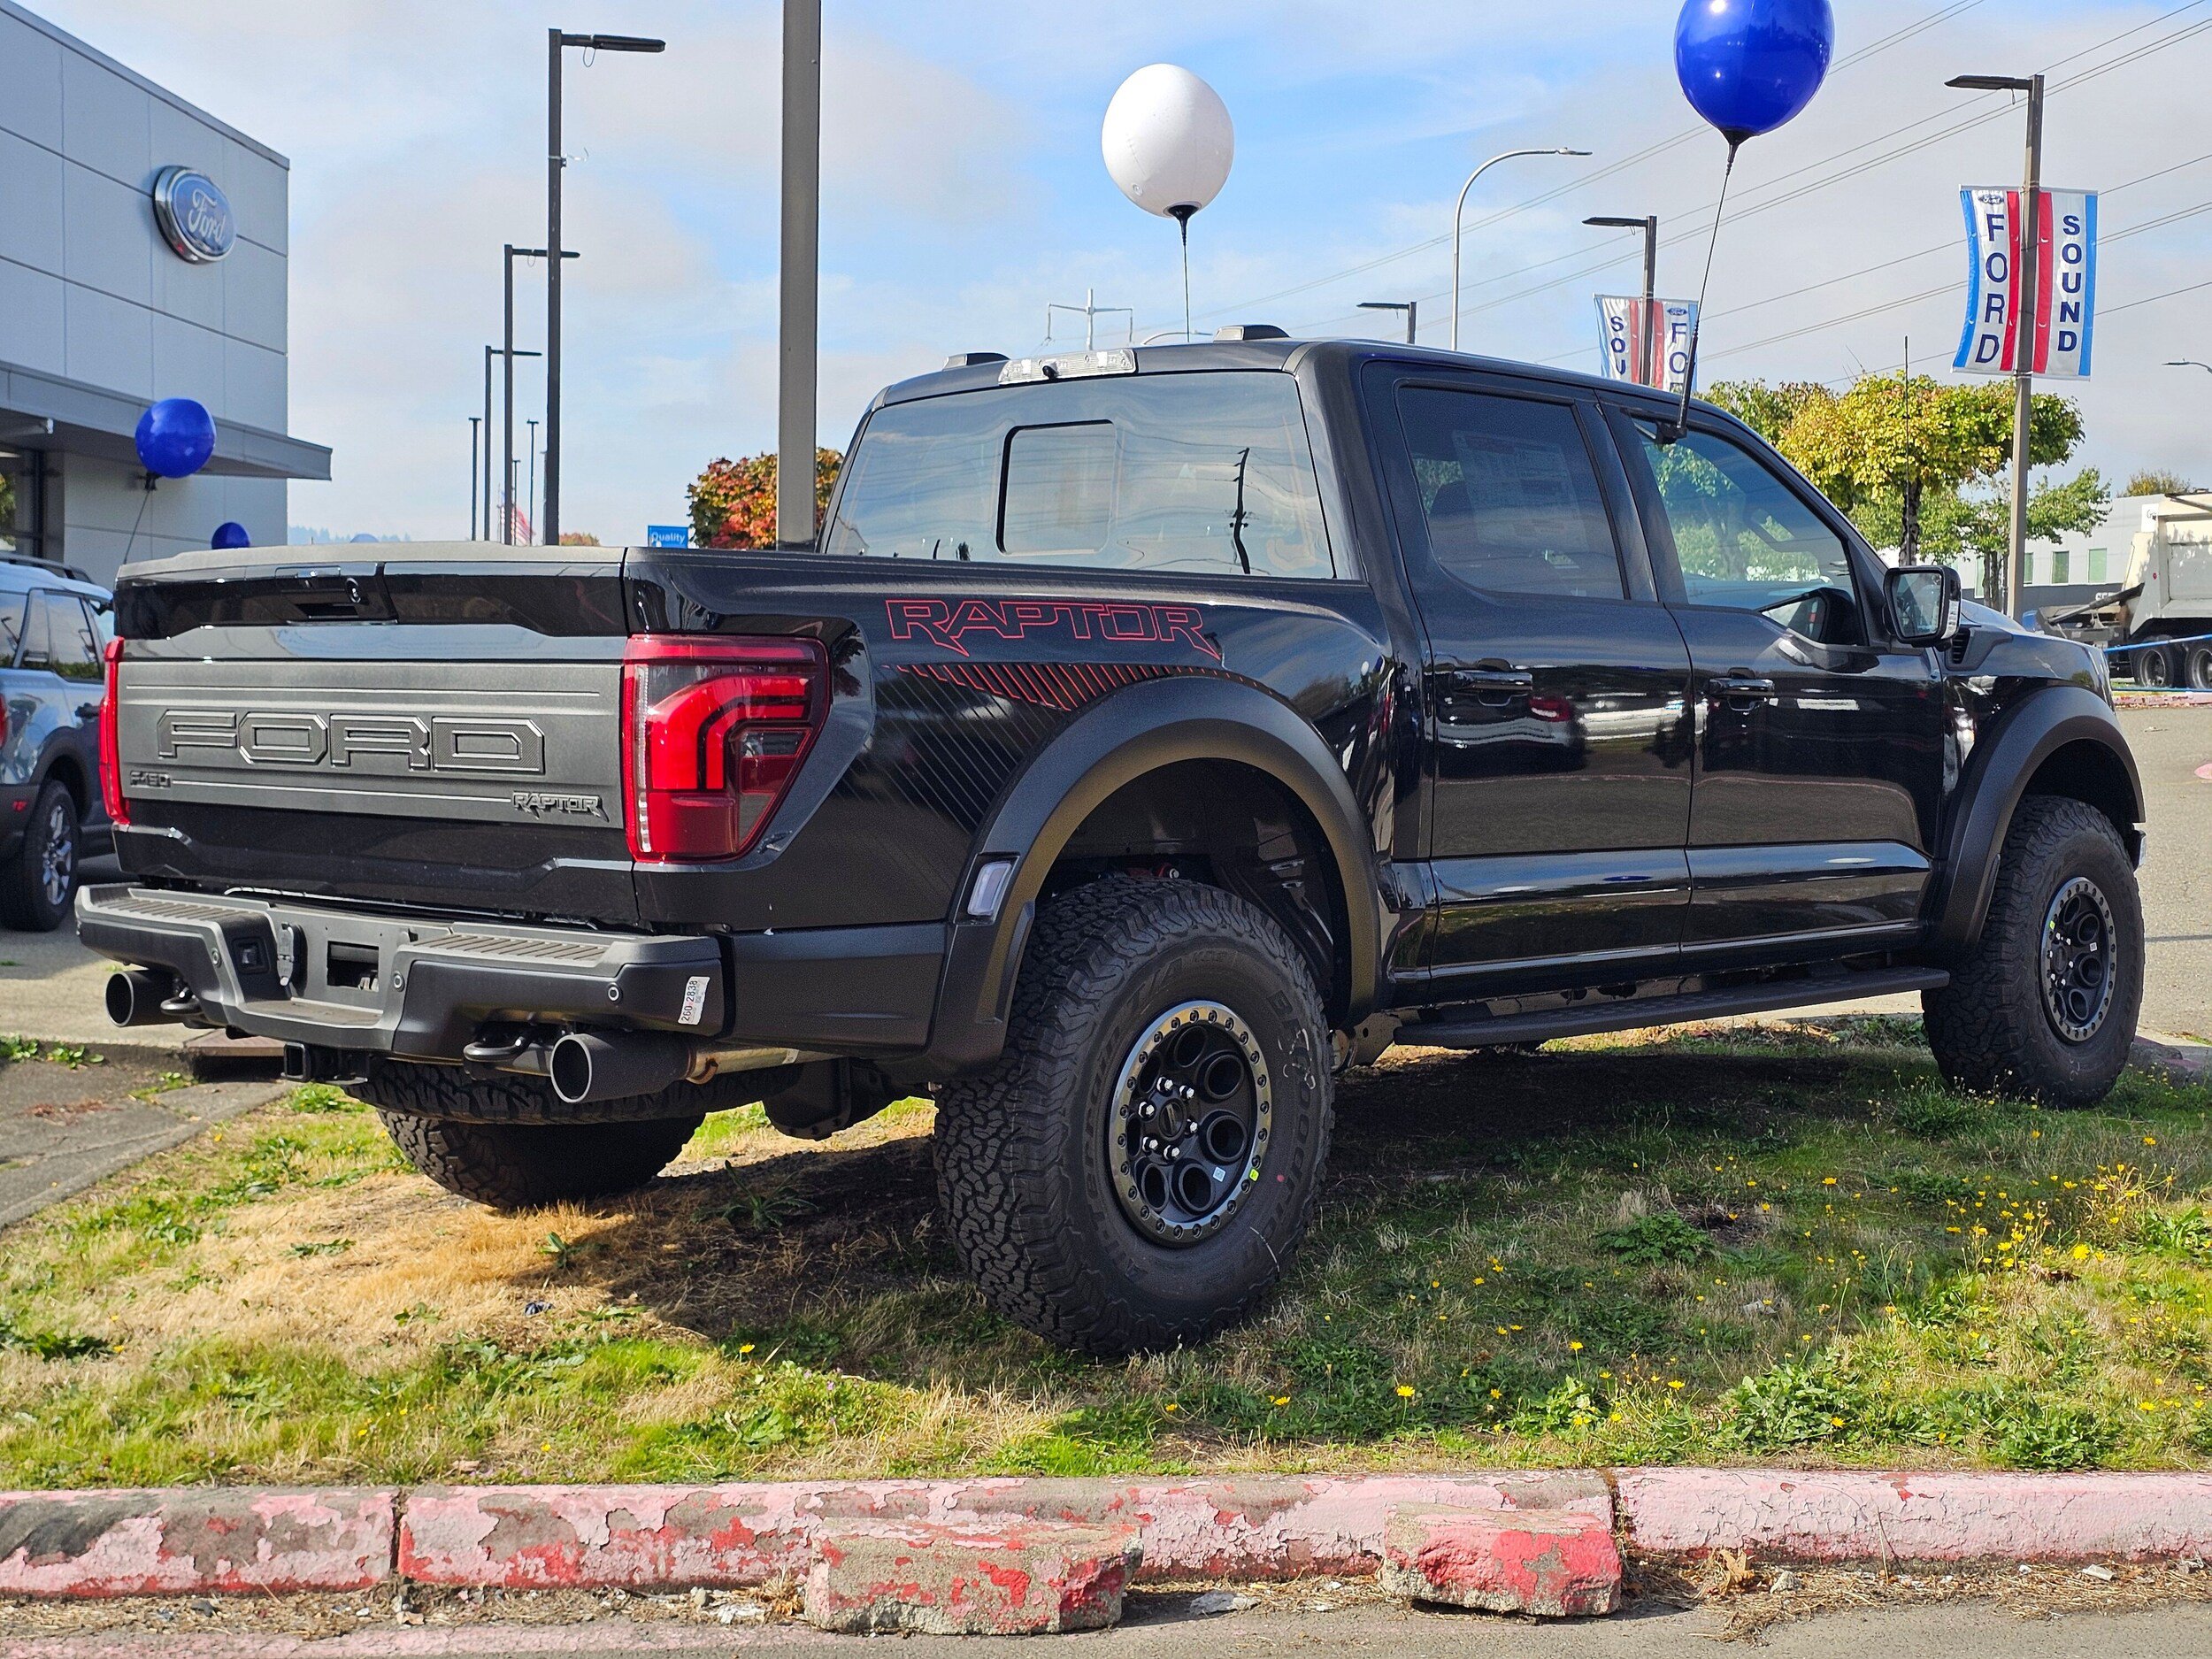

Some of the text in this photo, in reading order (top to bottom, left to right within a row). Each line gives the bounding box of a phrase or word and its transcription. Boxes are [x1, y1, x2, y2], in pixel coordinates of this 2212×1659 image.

[188, 188, 227, 245] Ford
[1975, 213, 2008, 364] FORD
[2057, 214, 2083, 352] SOUND
[1610, 315, 1626, 375] SOU
[1669, 322, 1687, 390] FO
[651, 531, 686, 545] Quality
[886, 600, 1222, 661] RAPTOR
[157, 710, 545, 774] FORD
[513, 791, 608, 822] RAPTOR
